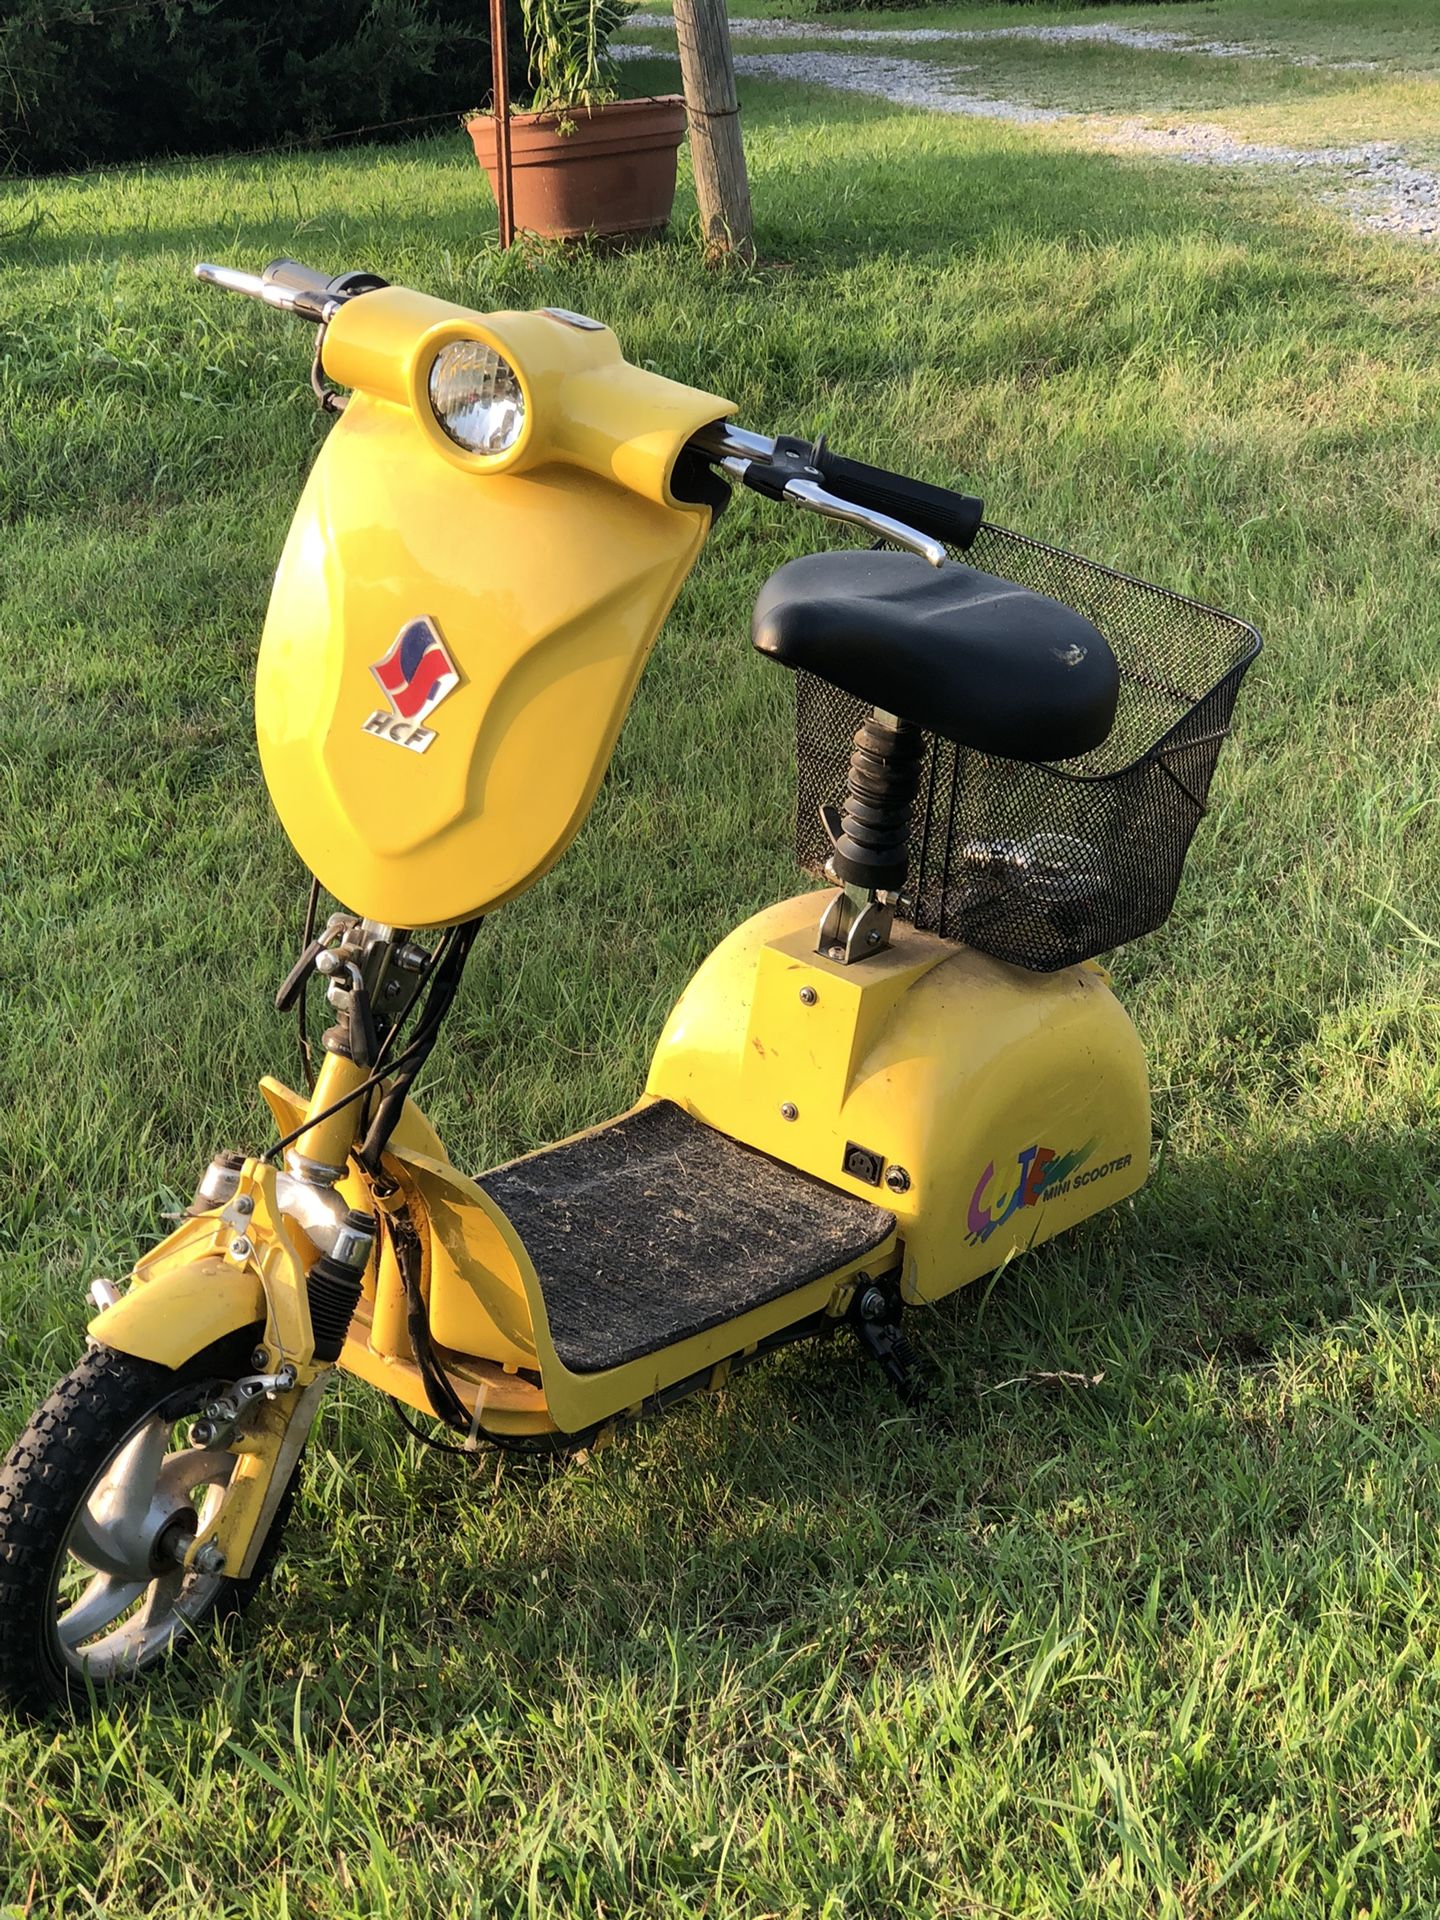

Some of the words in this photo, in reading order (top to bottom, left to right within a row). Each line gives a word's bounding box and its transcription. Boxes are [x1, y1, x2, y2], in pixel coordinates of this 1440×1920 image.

[365, 713, 429, 746] HCF
[967, 1145, 1056, 1233] CUTE
[1042, 1180, 1070, 1202] MINI
[1072, 1154, 1132, 1190] SCOOTER
